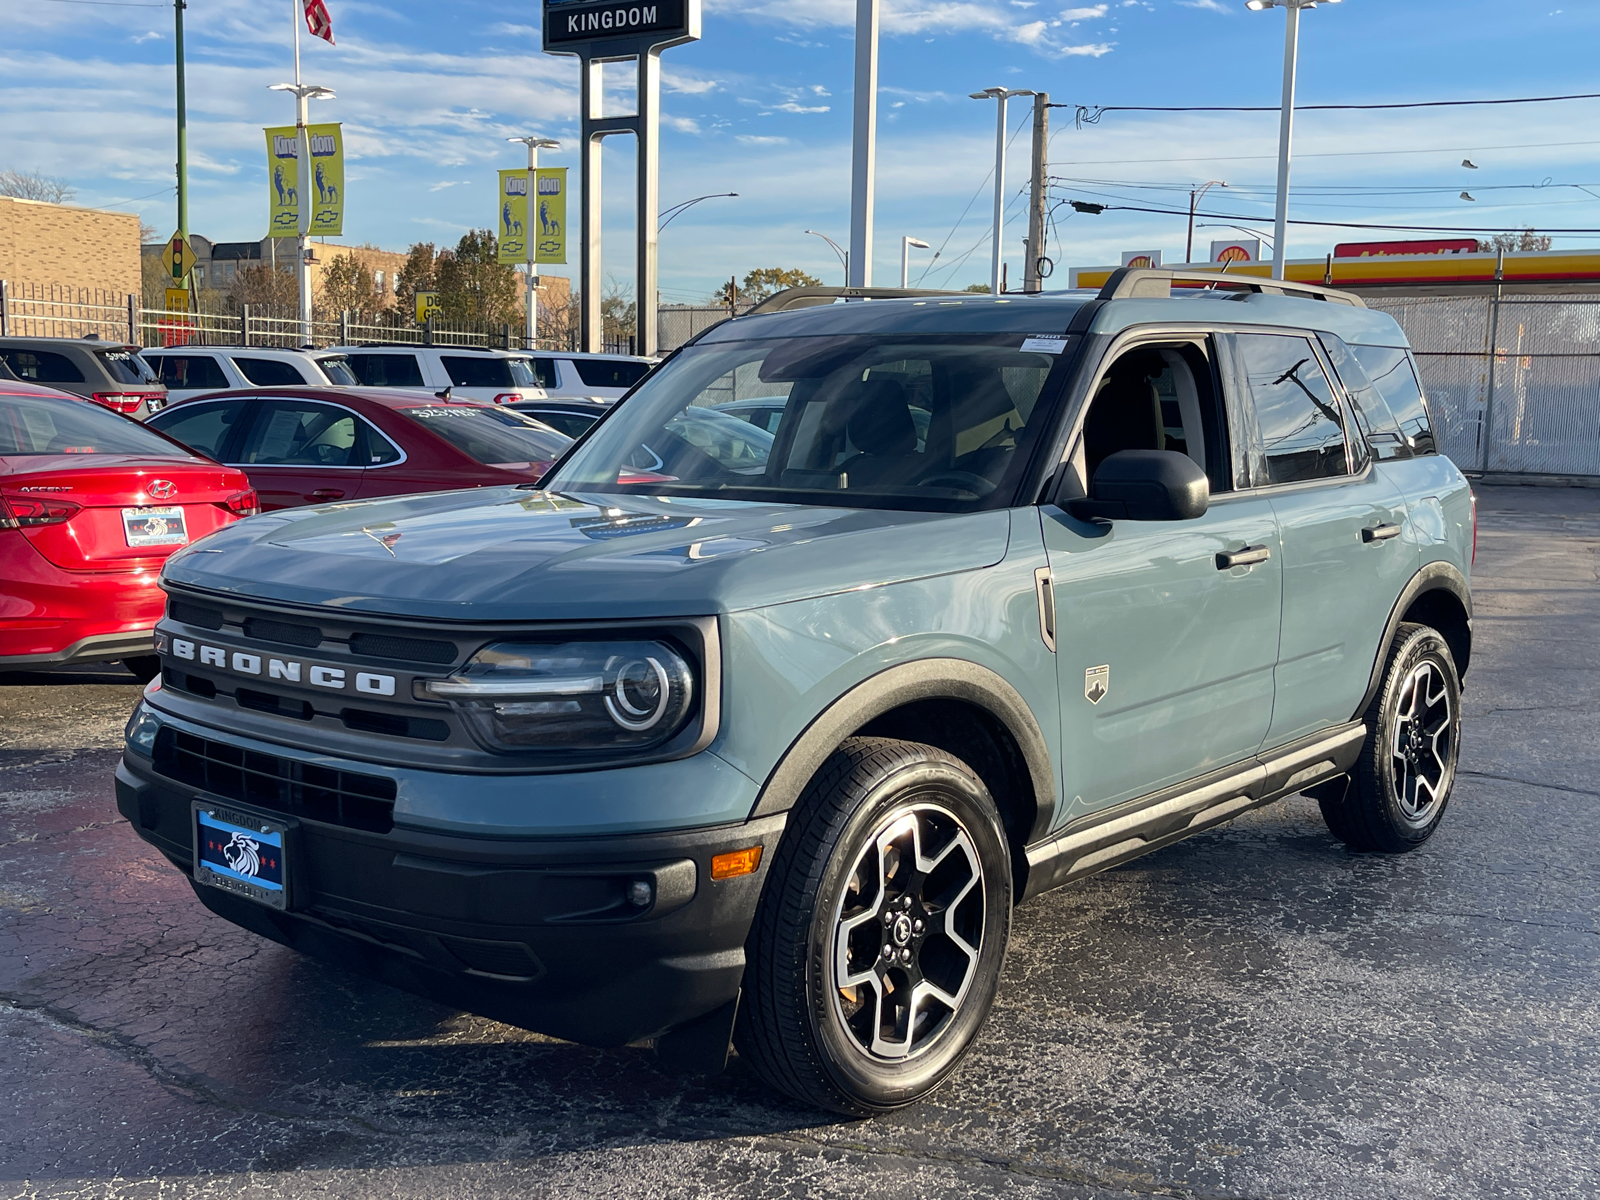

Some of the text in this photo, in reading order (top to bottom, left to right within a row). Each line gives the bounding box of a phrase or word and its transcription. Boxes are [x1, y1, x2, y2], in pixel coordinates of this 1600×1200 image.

[568, 5, 657, 33] KINGDOM
[273, 132, 336, 158] King dom
[505, 175, 560, 196] King dom
[172, 637, 396, 697] BRONCO
[213, 807, 262, 829] KINGDOM
[214, 876, 266, 900] CHEVROLET
